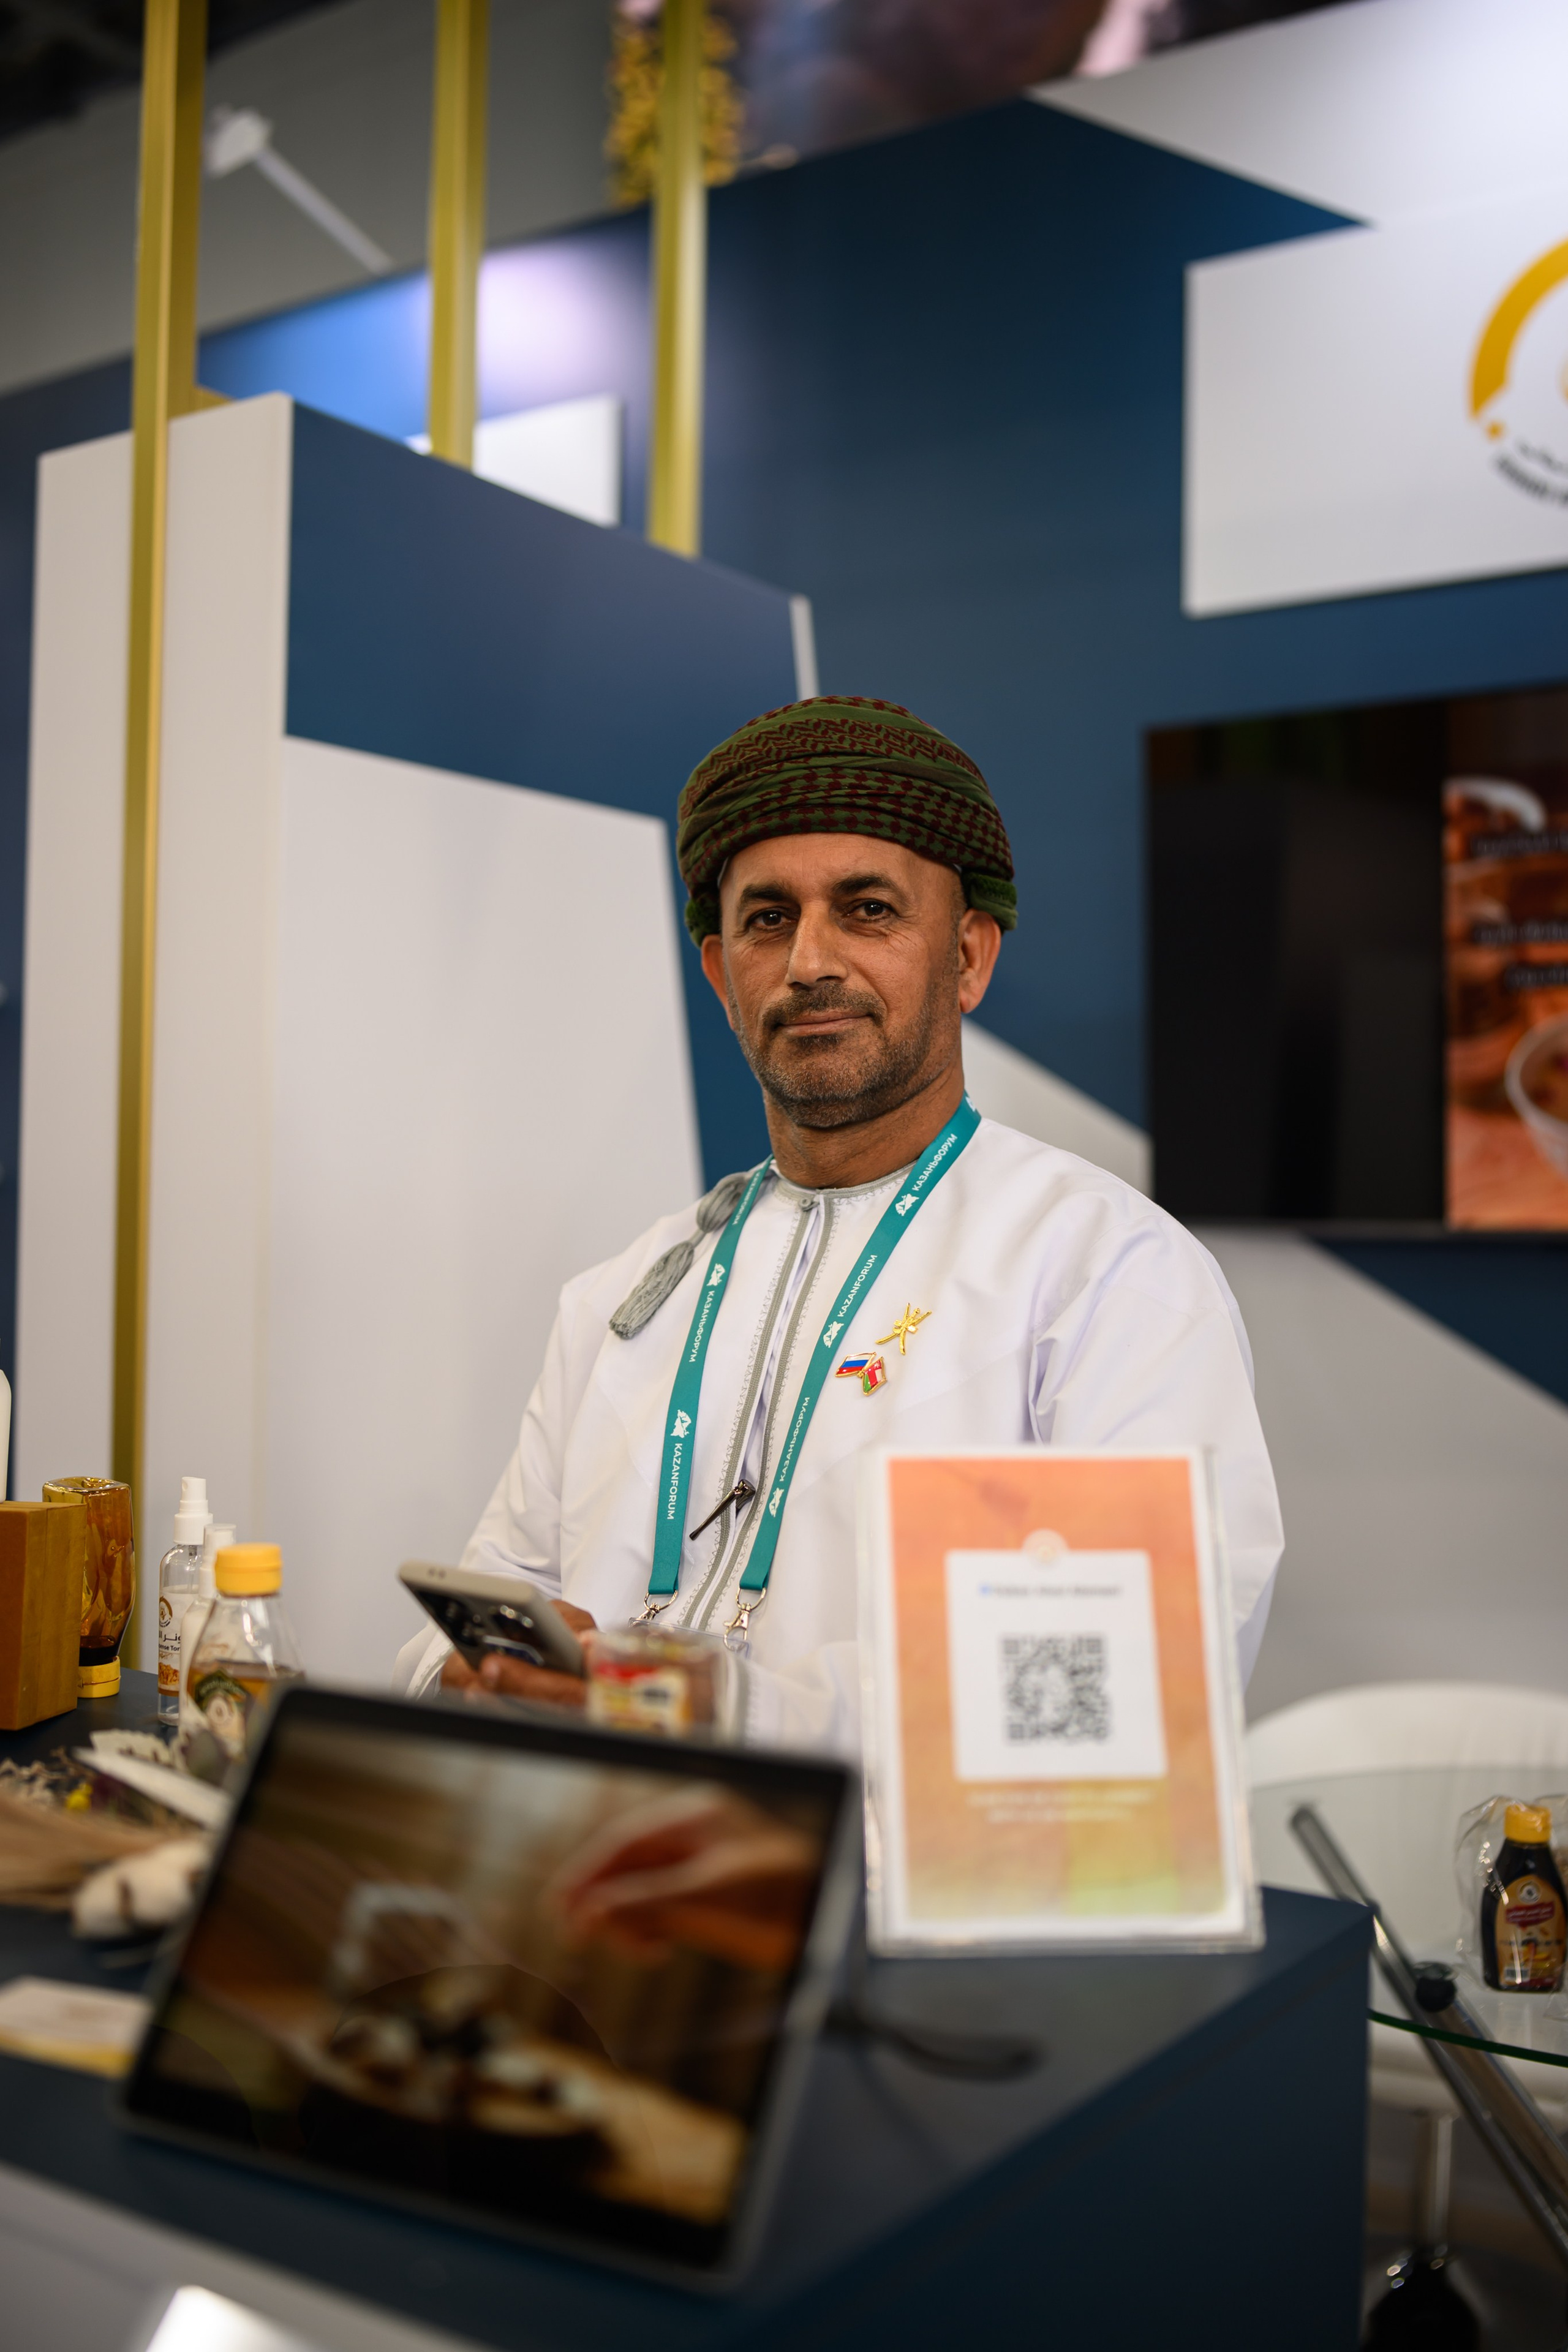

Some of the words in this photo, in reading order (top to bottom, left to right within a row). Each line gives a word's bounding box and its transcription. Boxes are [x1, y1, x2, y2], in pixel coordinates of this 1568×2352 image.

[911, 1133, 958, 1191] КАЗАНЬФОРУМ
[837, 1254, 878, 1317] KAZANFORUM
[689, 1291, 715, 1362] КАЗАНЬФОРУМ
[779, 1397, 810, 1482] КАЗАНЬФОРУМ
[667, 1443, 683, 1520] KAZANFORUM
